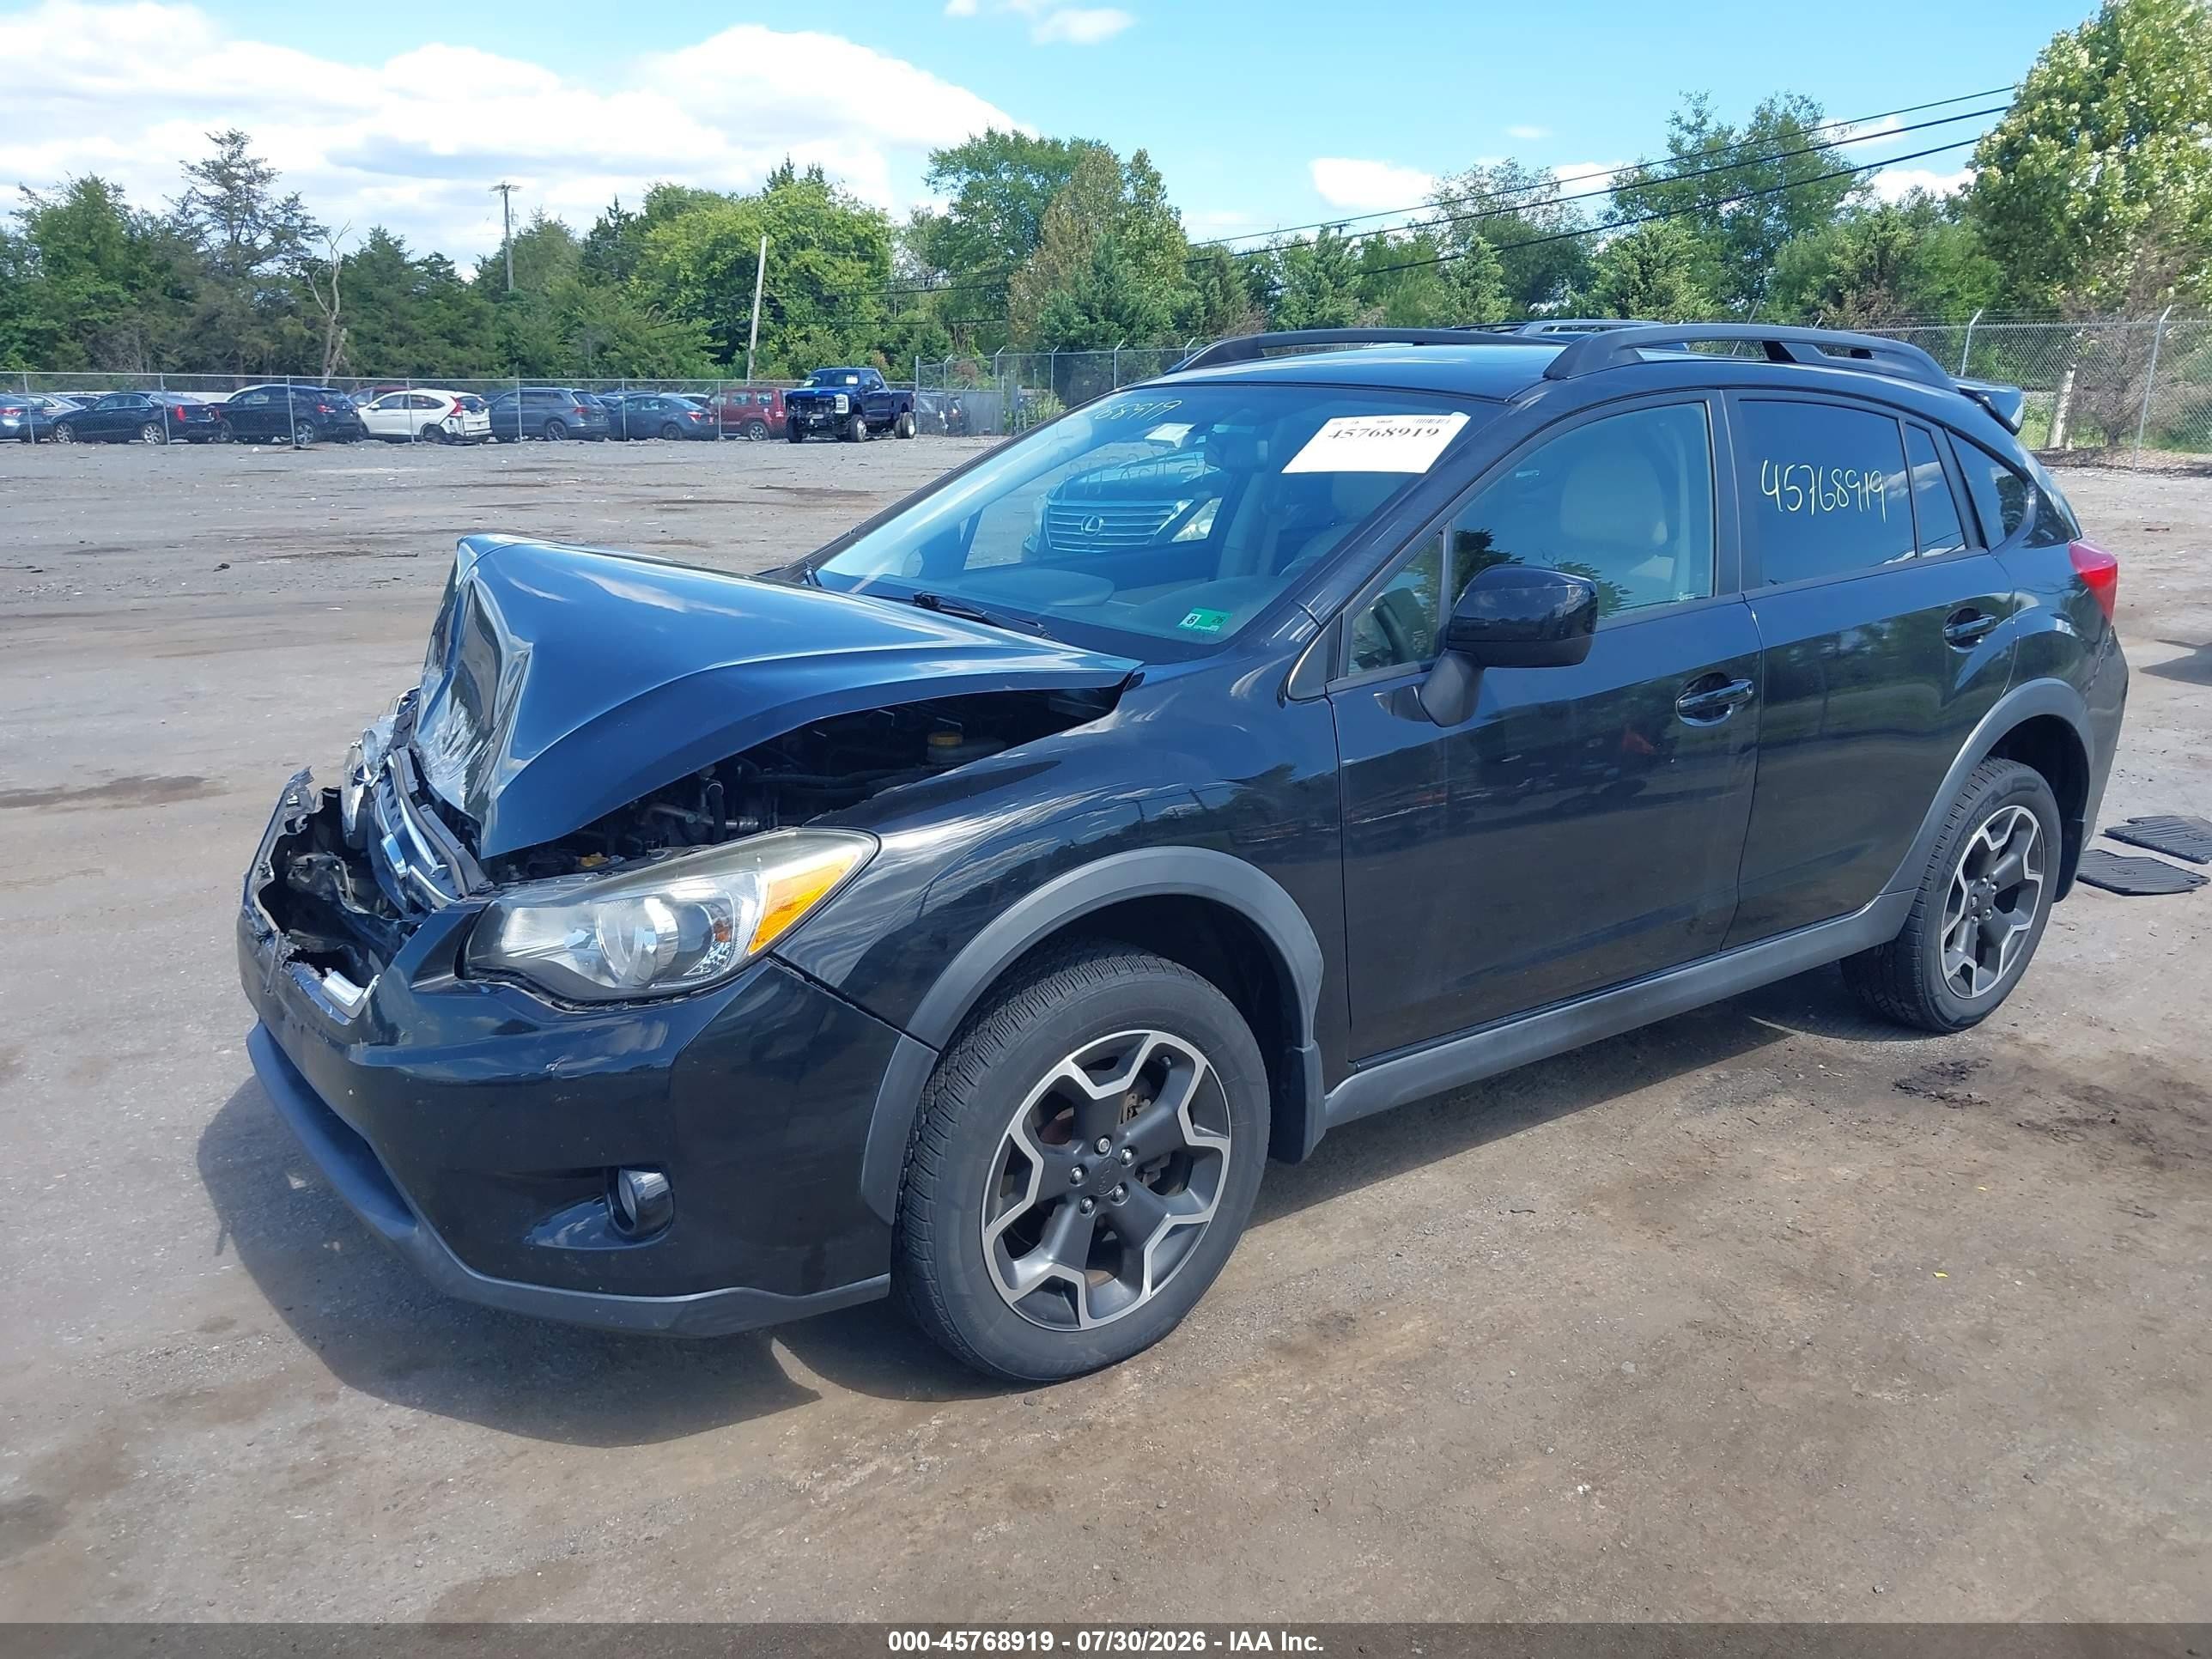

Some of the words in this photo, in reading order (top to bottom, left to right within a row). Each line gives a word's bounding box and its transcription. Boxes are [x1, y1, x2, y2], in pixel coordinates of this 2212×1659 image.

[1327, 427, 1440, 440] 45768919
[1760, 457, 1887, 523] 45768919
[1186, 615, 1198, 624] 8
